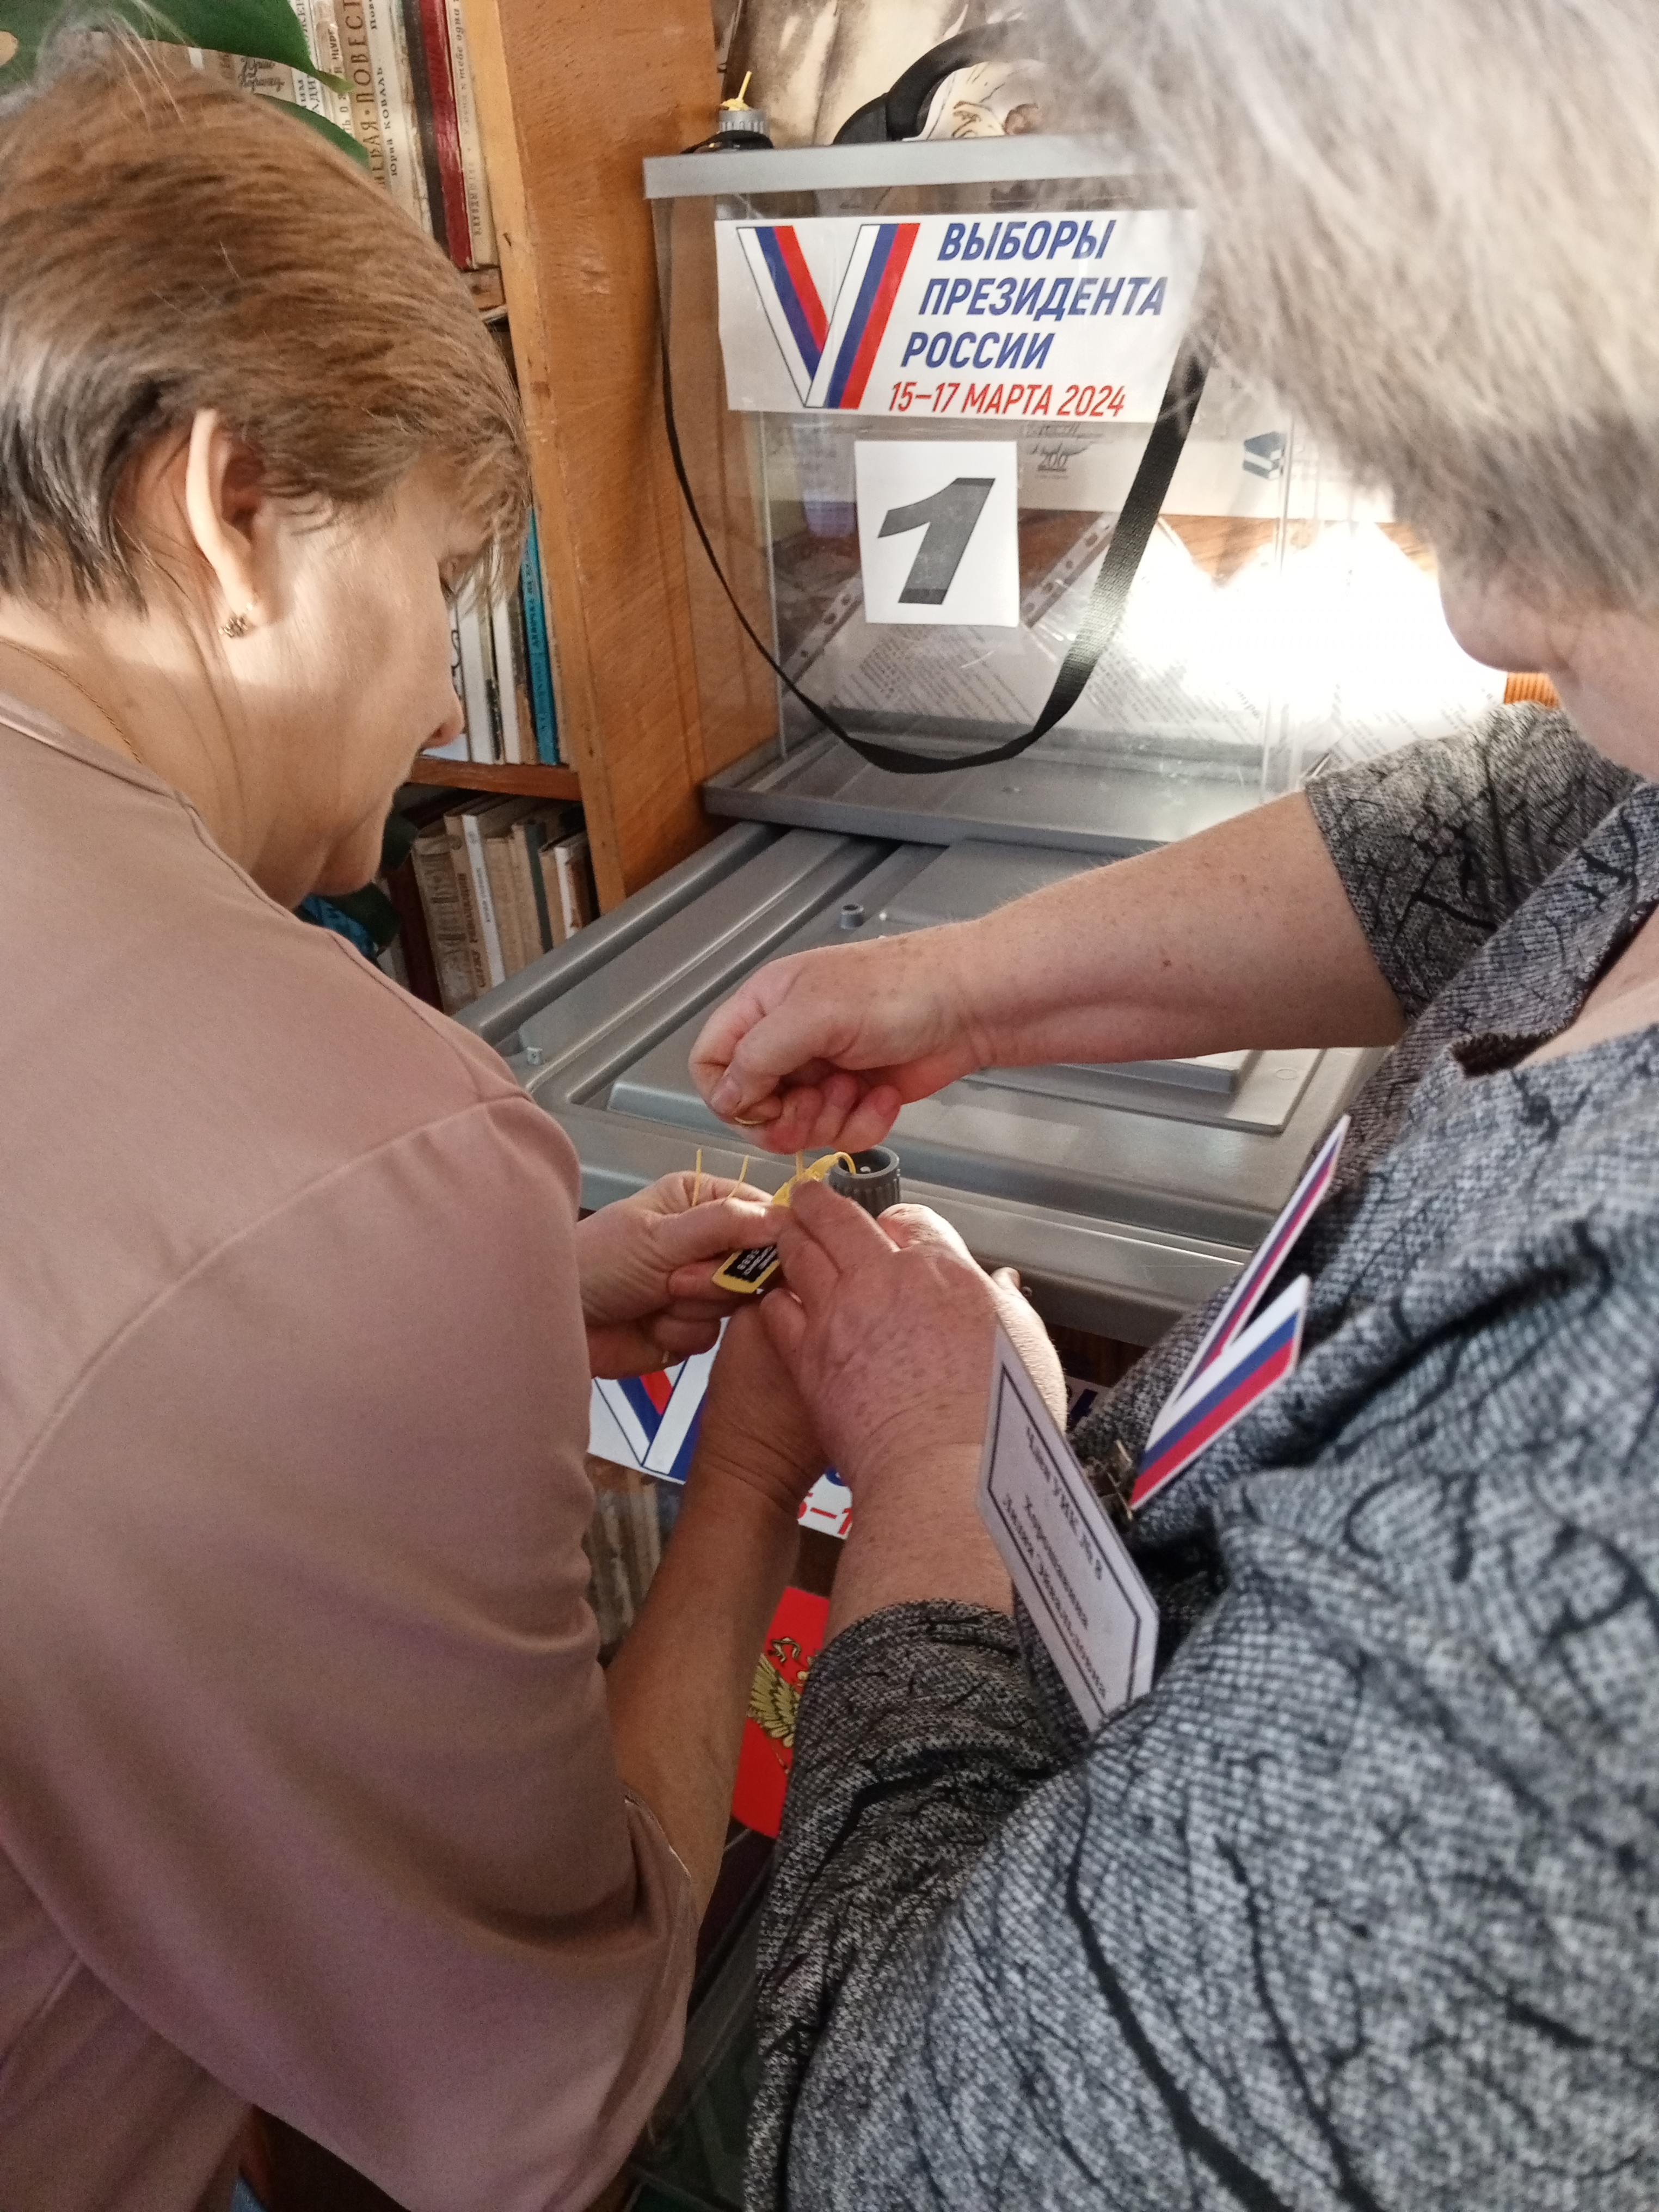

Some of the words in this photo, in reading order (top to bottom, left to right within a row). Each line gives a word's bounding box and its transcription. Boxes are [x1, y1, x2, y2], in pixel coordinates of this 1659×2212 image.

[369, 0, 377, 29] Пов
[453, 9, 465, 41] одна
[456, 46, 465, 79] тебе
[377, 67, 391, 130] КОВАЛЬ
[387, 138, 398, 176] Юрий
[937, 220, 1116, 261] ВЫБОРЫ
[918, 276, 1169, 322] ПРЕЗИДЕНТА
[901, 331, 1055, 369] РОССИИ
[963, 382, 1053, 416] МАРТА
[1057, 384, 1125, 417] 2024
[877, 477, 996, 605] 1
[1052, 1474, 1080, 1540] УИК
